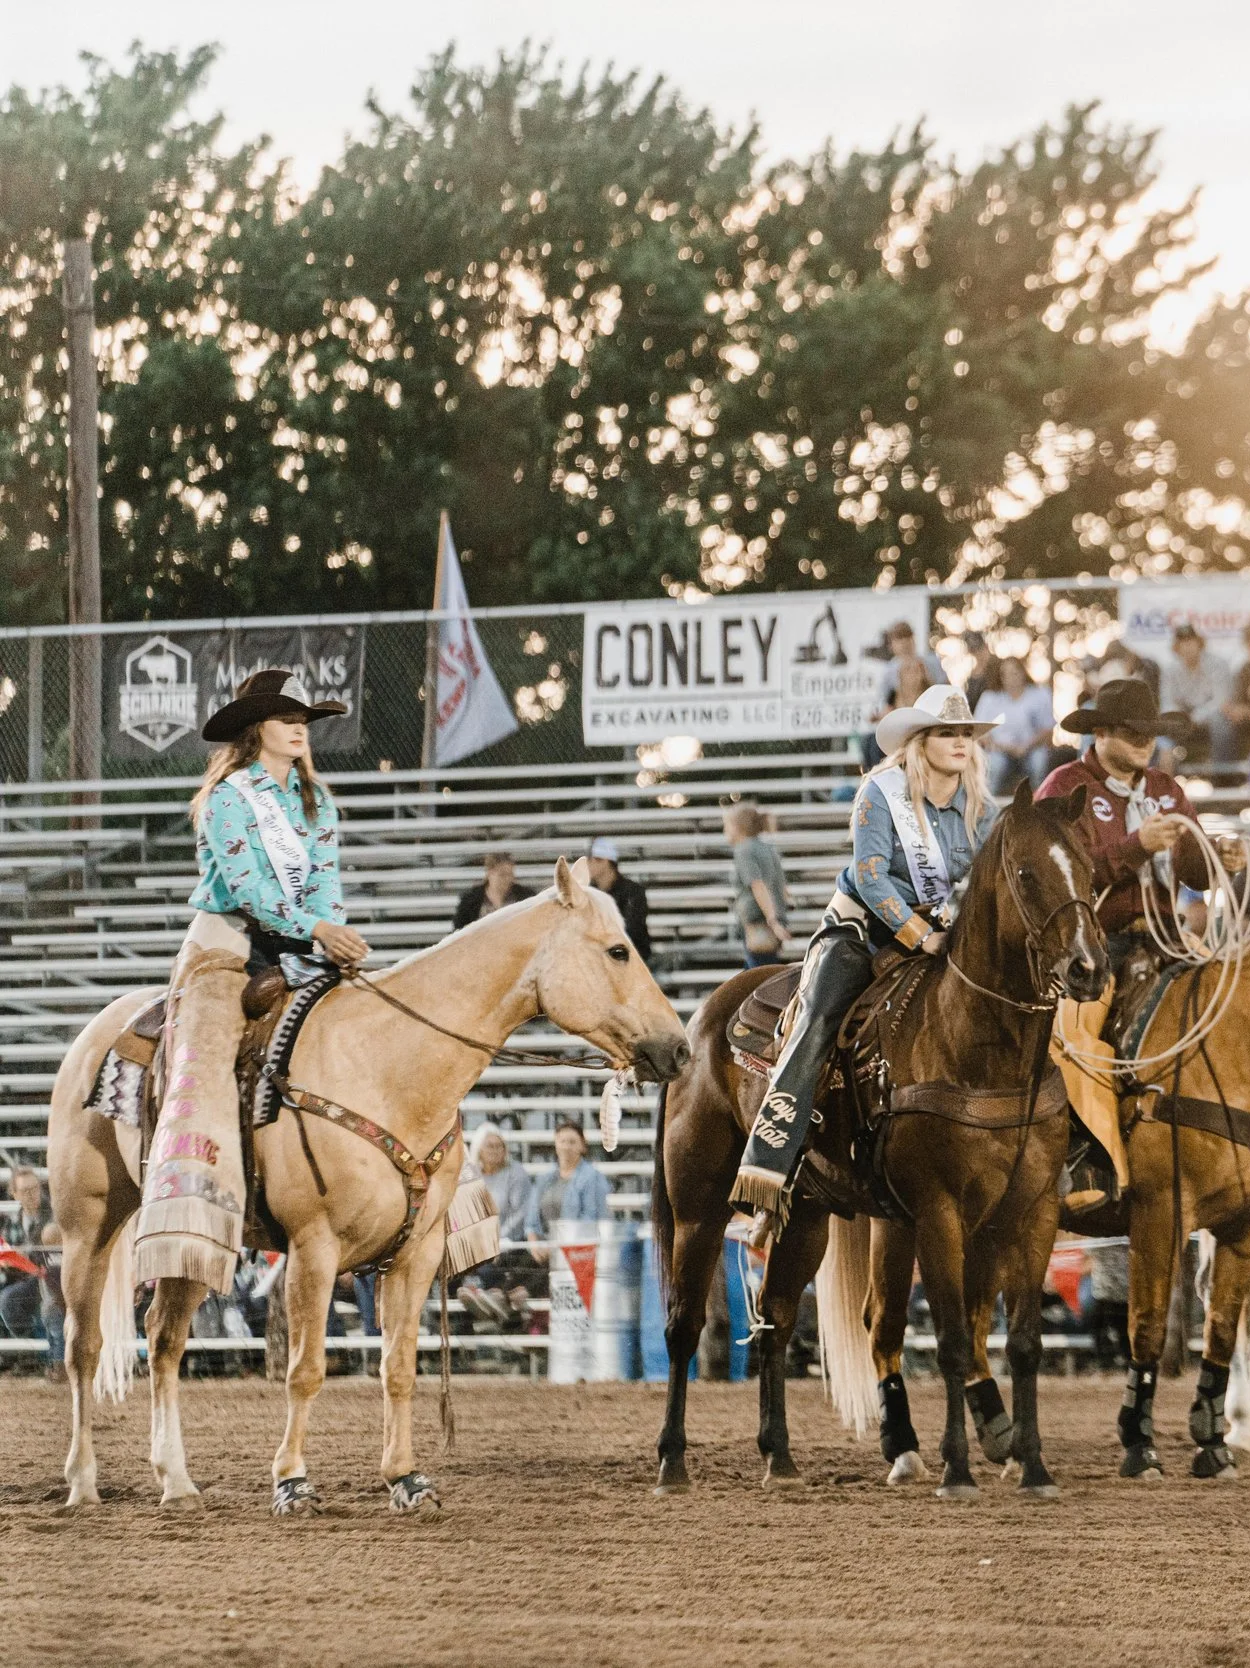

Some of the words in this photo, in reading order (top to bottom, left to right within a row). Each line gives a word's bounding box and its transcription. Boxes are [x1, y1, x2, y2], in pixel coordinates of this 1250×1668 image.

[595, 614, 777, 688] CONLEY
[319, 654, 347, 686] KS
[590, 706, 729, 728] EXCAVATING
